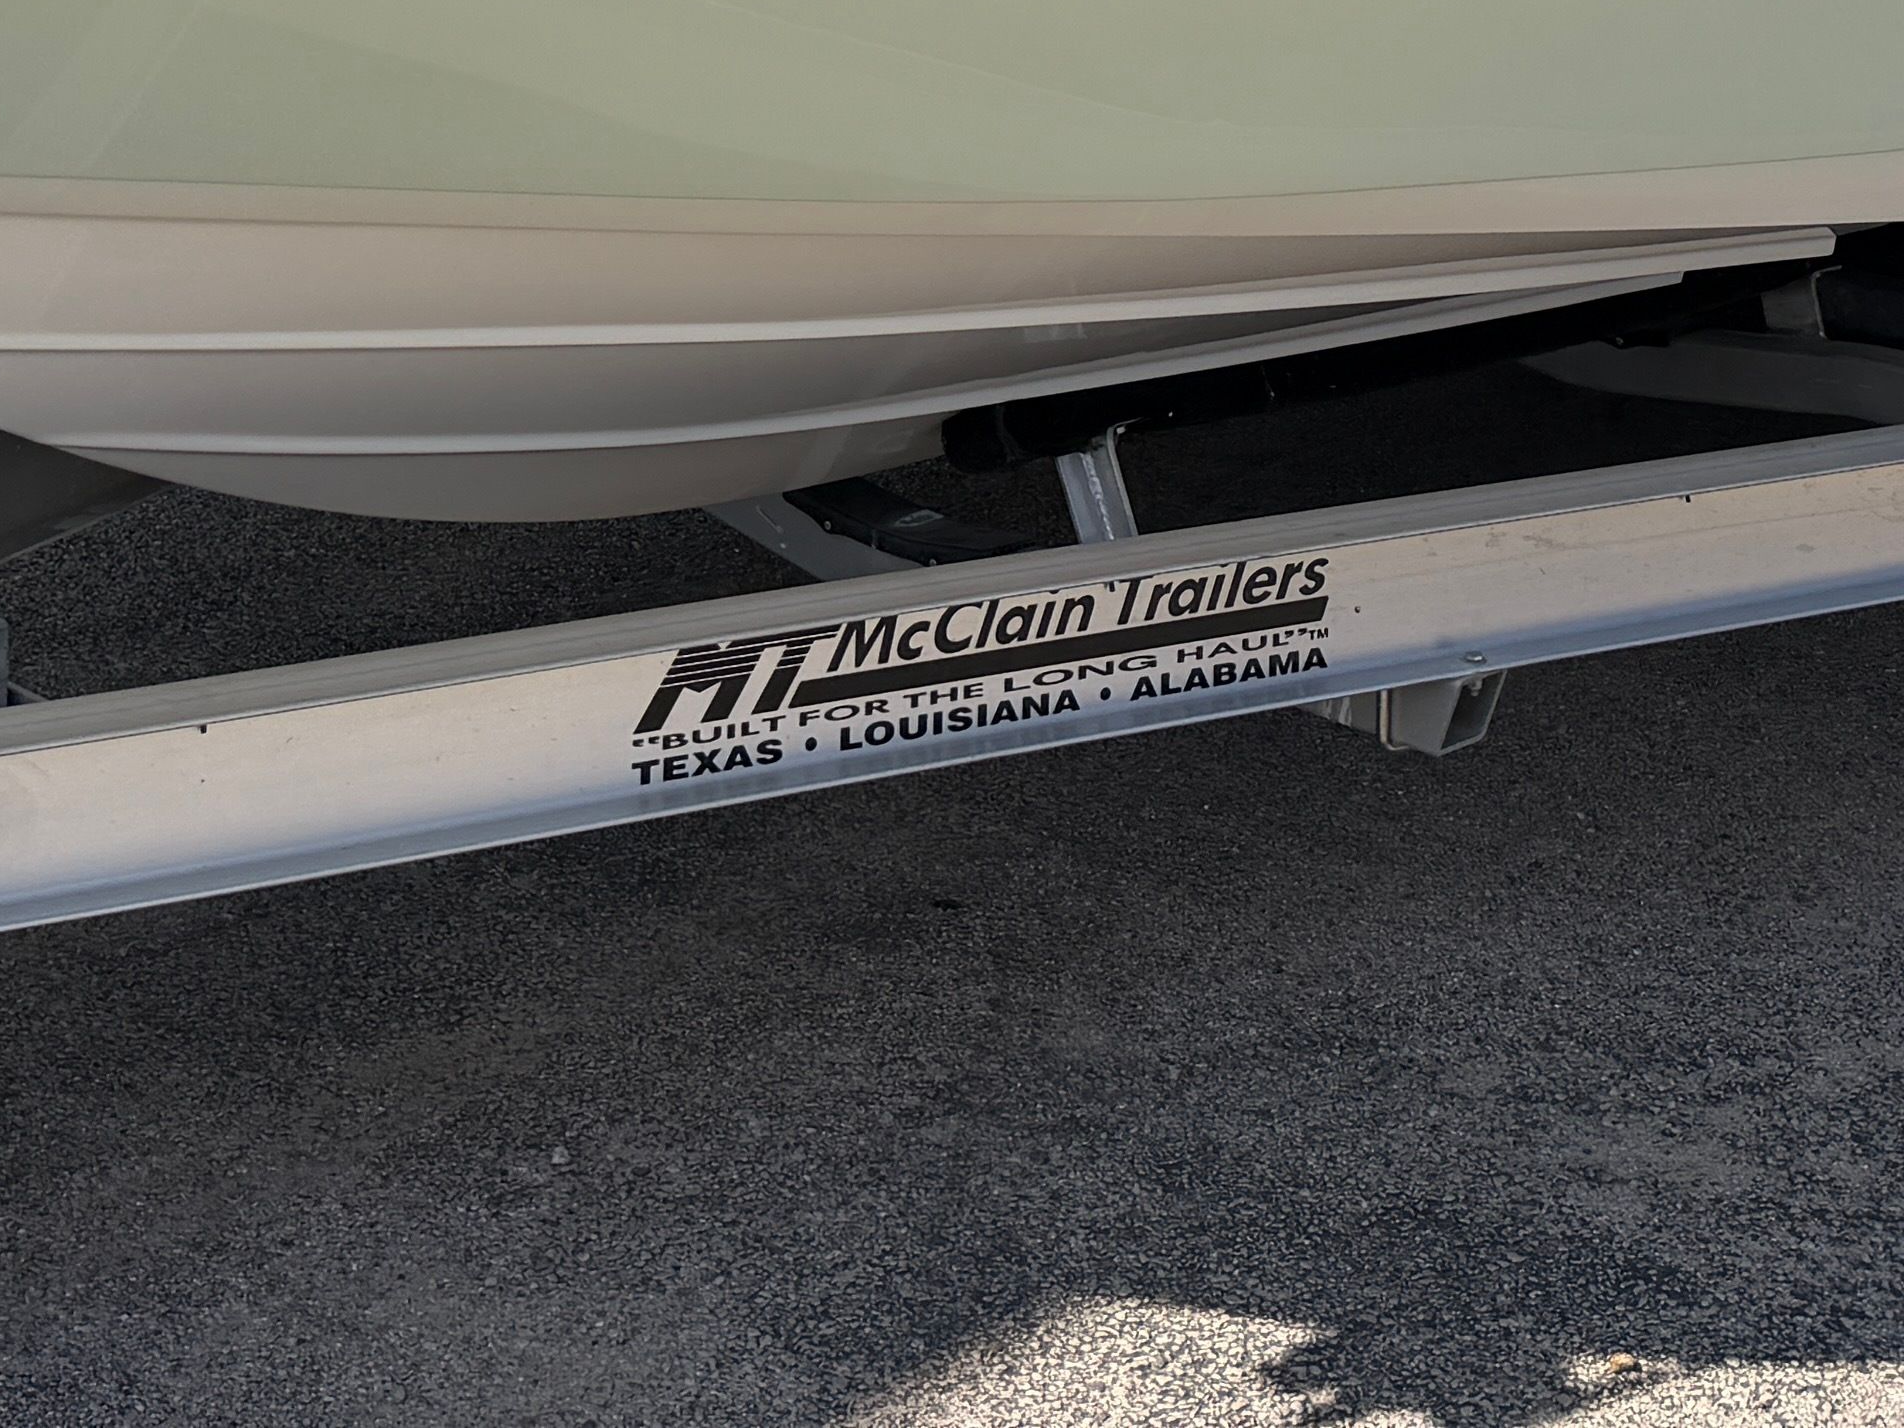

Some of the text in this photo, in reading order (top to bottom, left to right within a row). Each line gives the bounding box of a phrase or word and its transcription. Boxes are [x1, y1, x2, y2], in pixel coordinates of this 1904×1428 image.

[826, 589, 1095, 673] McClain
[1104, 556, 1330, 625] Trailers
[631, 647, 1329, 785] TEXAS LOUISIANA ALABAMA
[798, 699, 890, 727] FOR
[902, 681, 985, 709] THE
[1003, 655, 1158, 692] LONG
